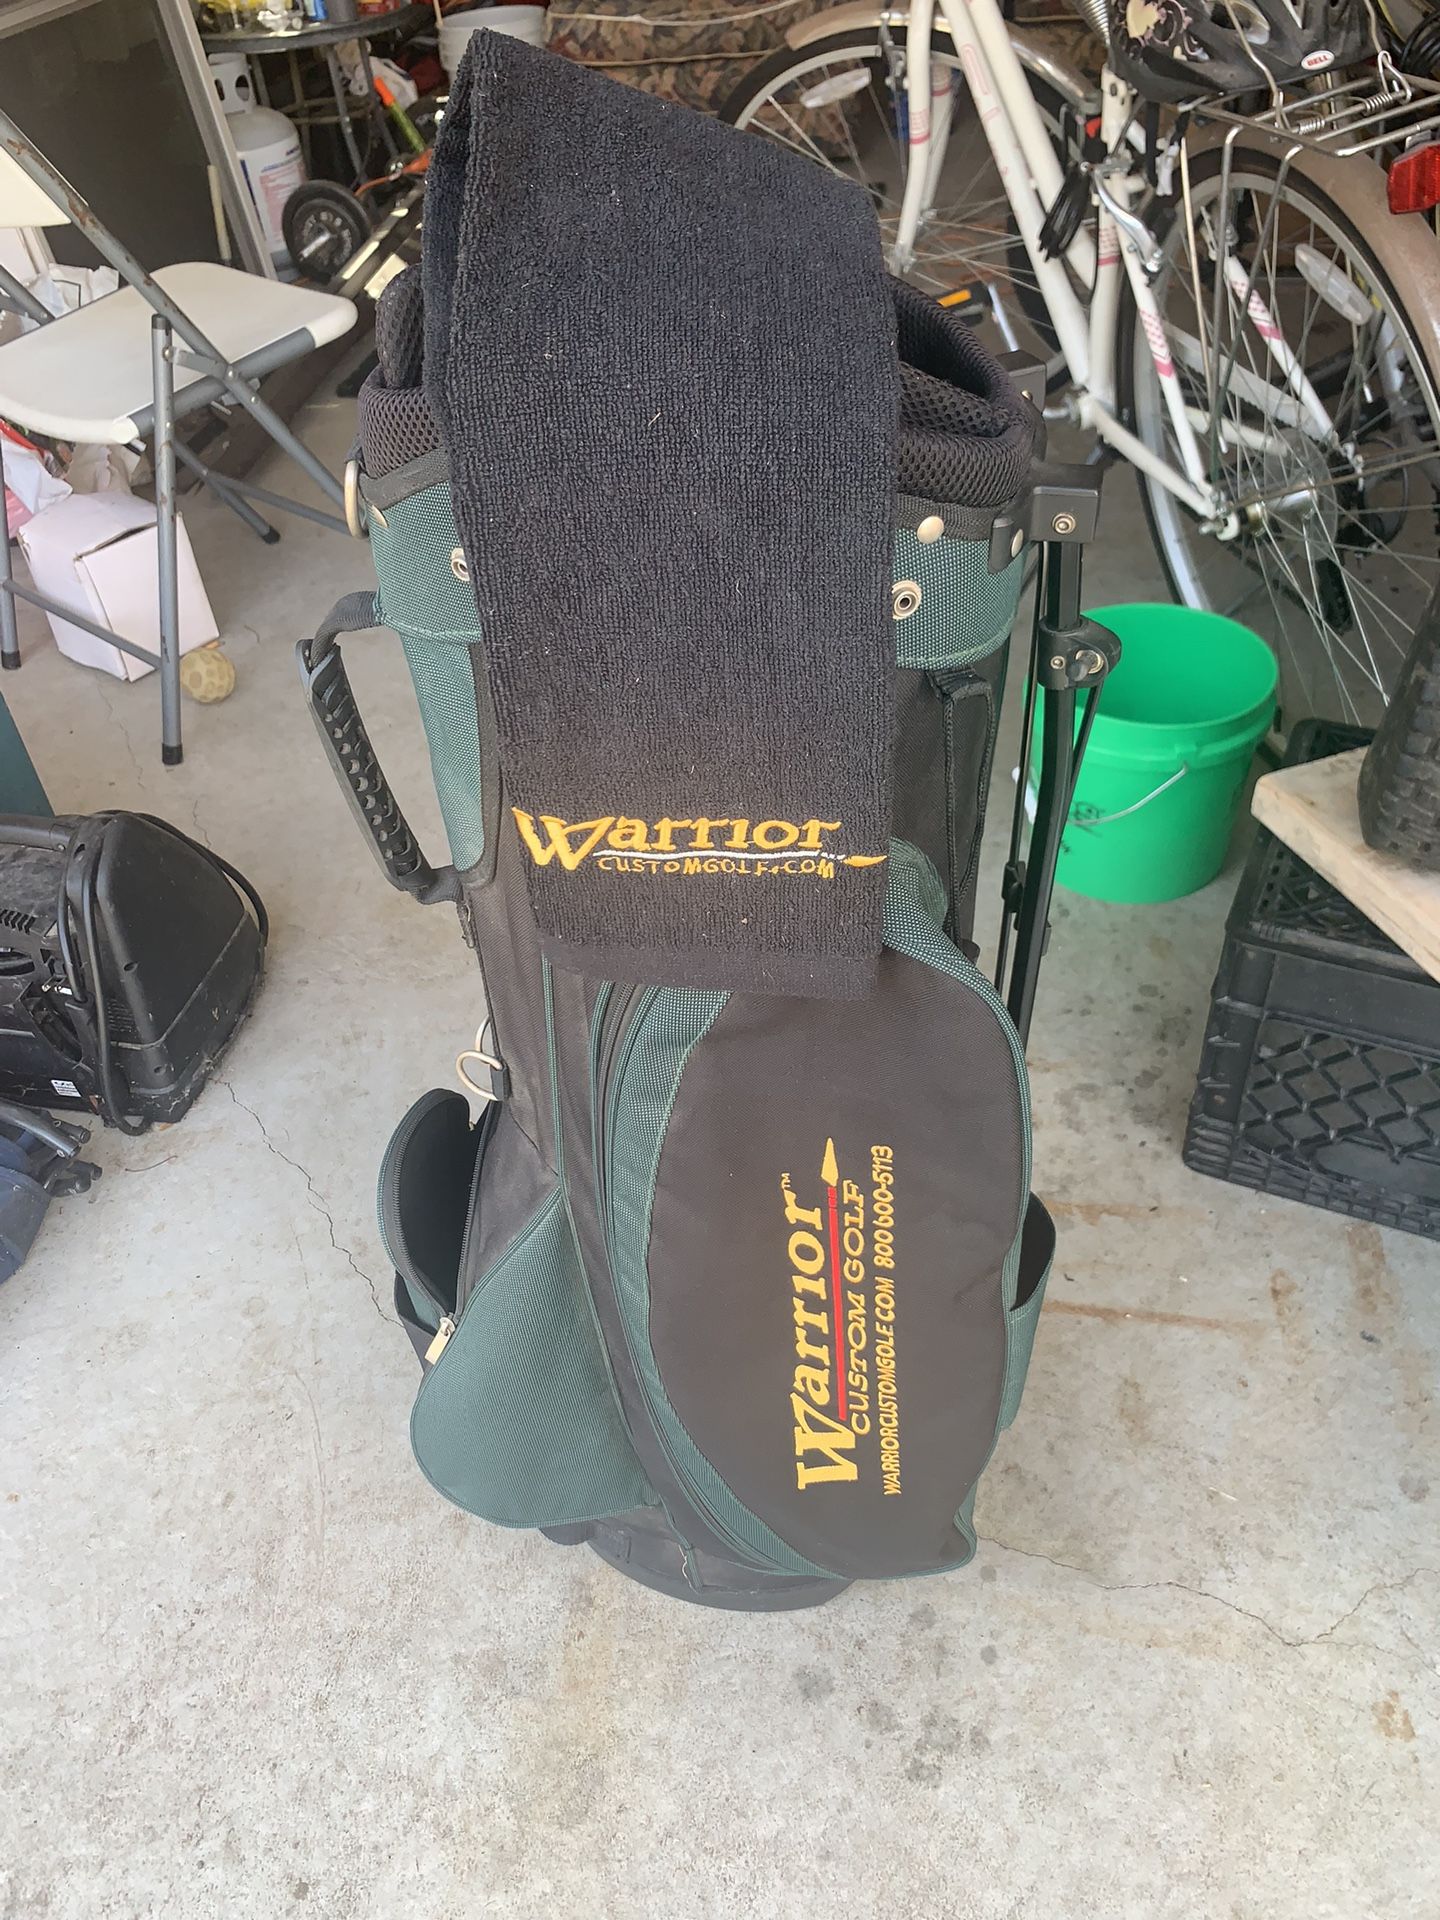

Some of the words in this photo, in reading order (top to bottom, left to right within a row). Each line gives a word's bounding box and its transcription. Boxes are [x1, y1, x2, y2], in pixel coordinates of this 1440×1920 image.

[1307, 55, 1329, 66] BELL
[511, 806, 842, 871] Warrior
[842, 1179, 866, 1285] GOLF
[784, 1190, 859, 1491] Warrior
[846, 1290, 871, 1436] CUSTOM
